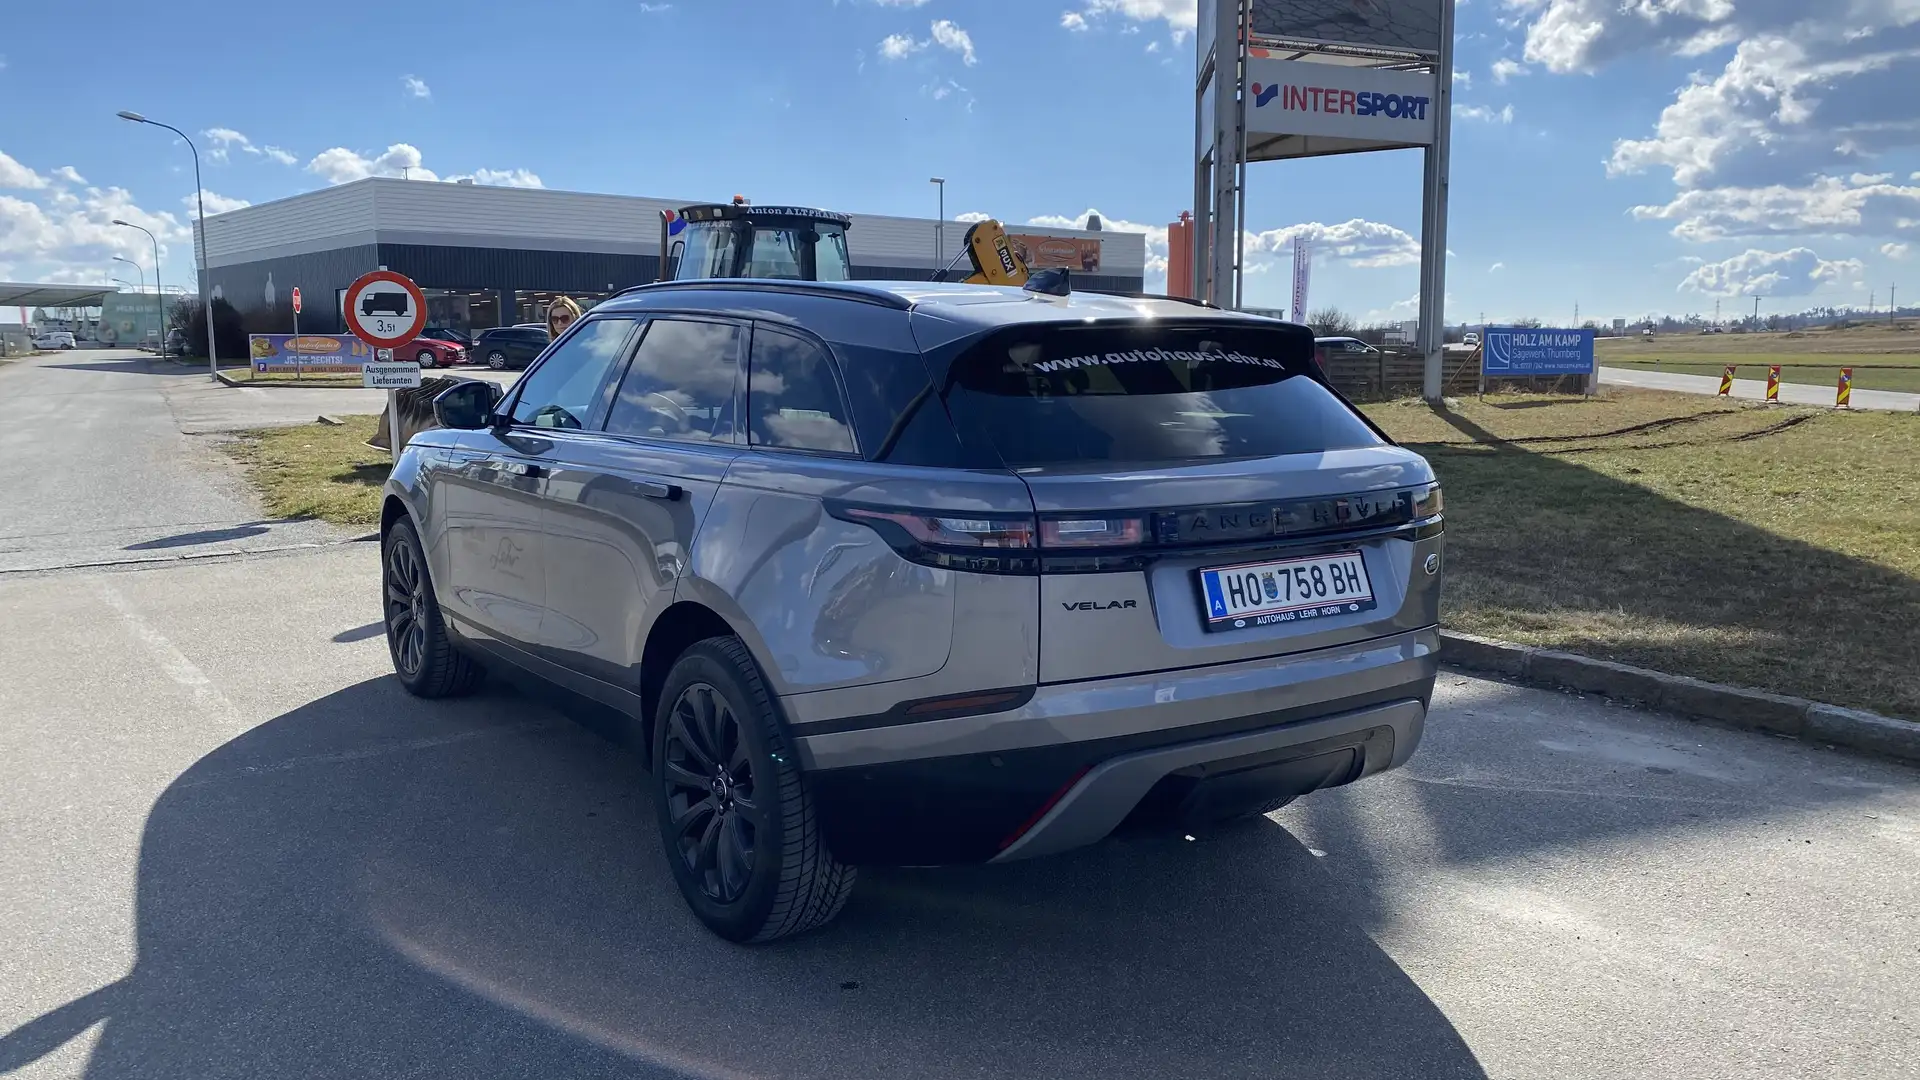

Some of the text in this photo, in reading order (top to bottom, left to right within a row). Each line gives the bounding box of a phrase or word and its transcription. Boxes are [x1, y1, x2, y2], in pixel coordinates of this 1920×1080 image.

[1283, 84, 1430, 120] INTERSPORT
[746, 206, 782, 215] Anton
[377, 319, 396, 333] 3,5t
[1512, 333, 1581, 347] HOLZ AM KAMP
[1033, 346, 1285, 371] www.autohaus-lehr.at
[365, 365, 419, 375] Ausgenommen
[372, 376, 412, 385] Lieferanten
[1227, 561, 1362, 608] HO 758 BH
[1062, 599, 1137, 611] VELAR
[1214, 600, 1223, 610] A
[1257, 611, 1296, 625] AUTOHAUS
[1299, 608, 1318, 619] LEHR
[1321, 605, 1341, 616] HORN
